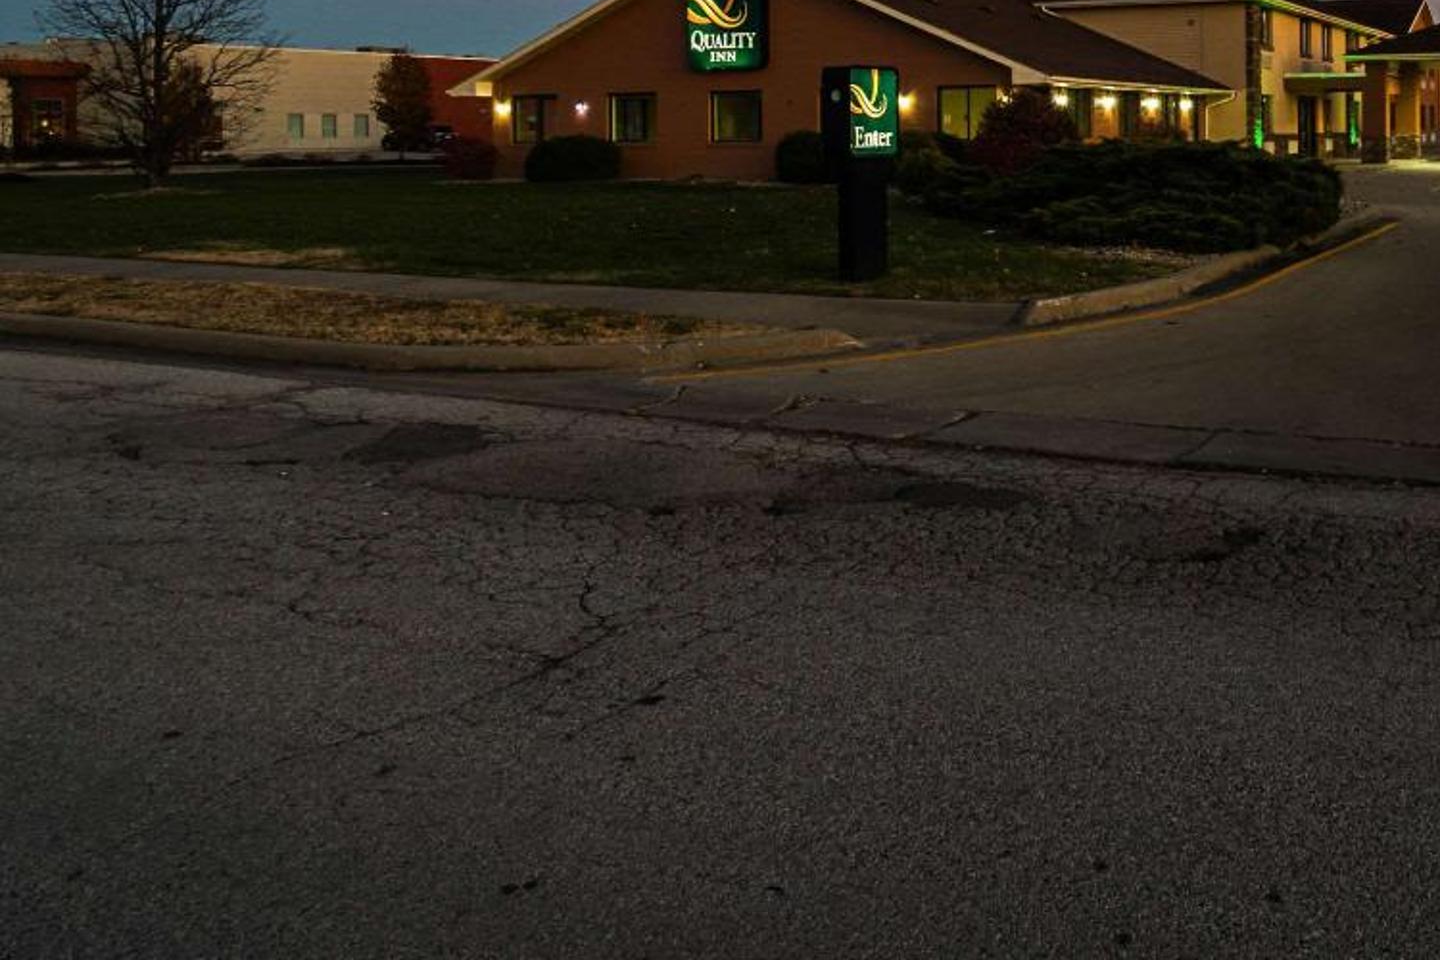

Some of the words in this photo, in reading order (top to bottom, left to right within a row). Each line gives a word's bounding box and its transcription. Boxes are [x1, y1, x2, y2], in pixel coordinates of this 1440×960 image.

[691, 30, 756, 52] QUALITY
[710, 51, 736, 62] INN
[854, 126, 893, 148] Enter
